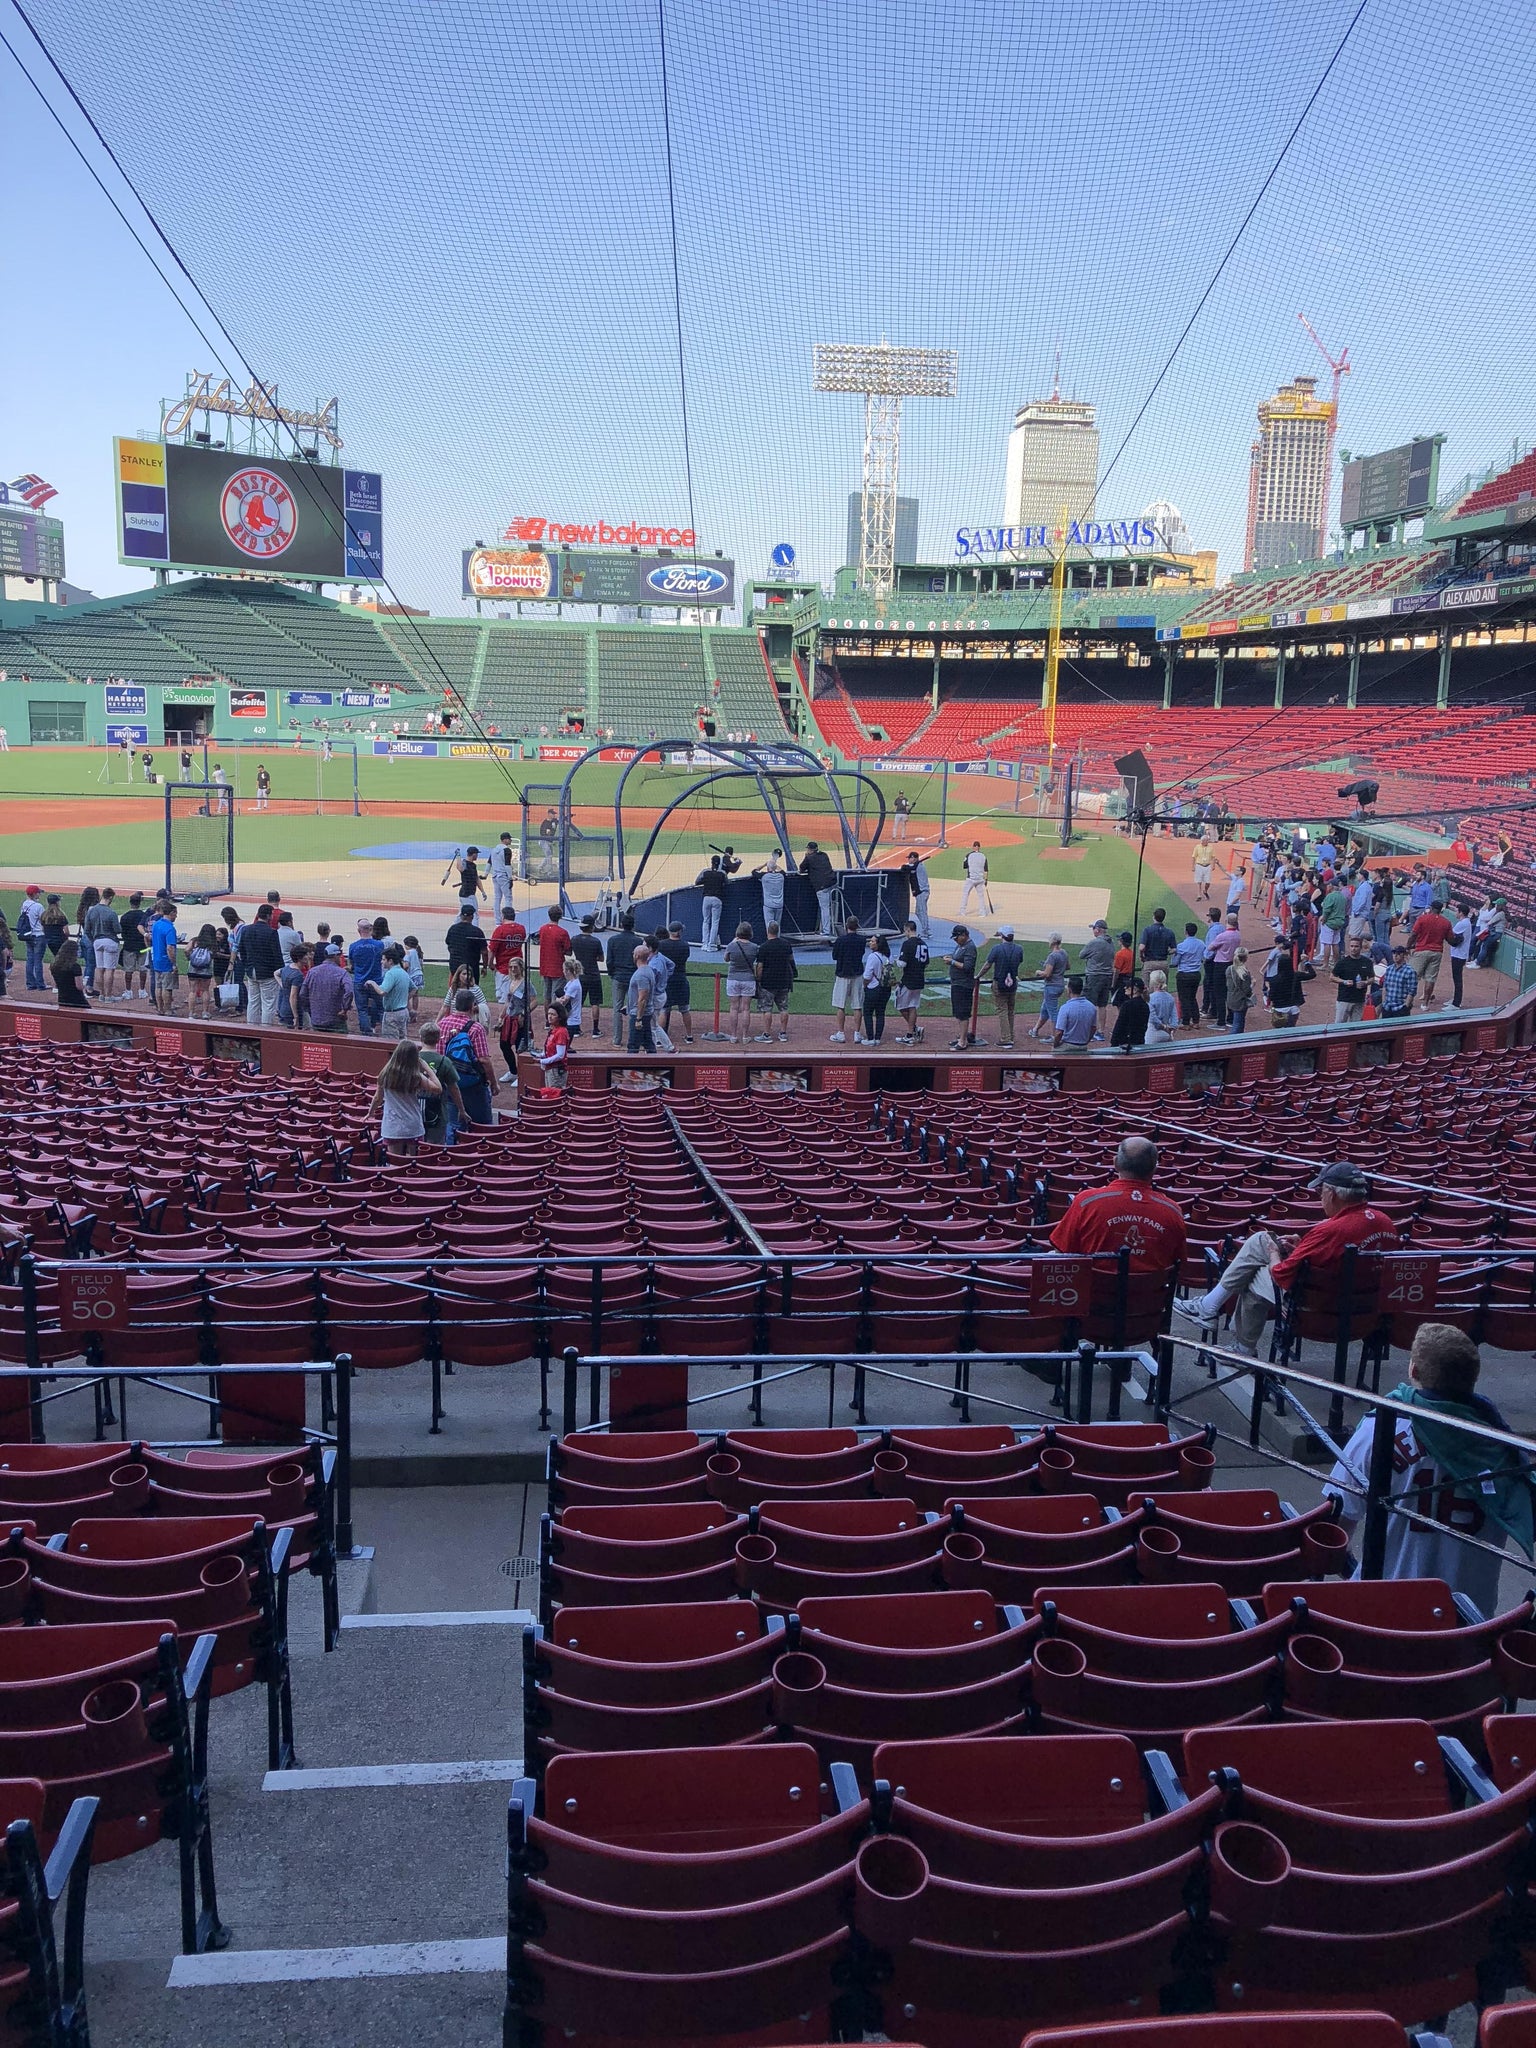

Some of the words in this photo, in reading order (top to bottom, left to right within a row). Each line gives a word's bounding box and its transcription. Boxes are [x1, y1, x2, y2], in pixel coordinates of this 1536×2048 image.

[162, 368, 236, 436] John
[238, 378, 344, 449] Hancock
[121, 455, 163, 467] STANLEY
[230, 475, 288, 504] BOSTON
[130, 516, 159, 526] StubHub
[230, 523, 258, 549] RED
[264, 526, 289, 552] SOX
[550, 523, 595, 543] new
[599, 519, 696, 547] balance
[955, 526, 1048, 557] SAMUEL
[1066, 518, 1156, 547] ADAMS
[347, 547, 381, 559] Ballpark
[495, 576, 542, 587] DONUTS
[663, 568, 712, 591] Ford
[1446, 592, 1463, 606] ALEX
[1464, 590, 1481, 604] AND
[1481, 587, 1497, 601] ANI
[108, 695, 144, 703] HARBOR
[174, 694, 215, 703] sunovion
[231, 698, 265, 706] Safelite
[347, 694, 370, 706] NESN
[390, 742, 423, 754] etBlue
[451, 745, 489, 756] GRANITE
[494, 745, 512, 757] CITY
[881, 763, 902, 771] TOYO
[903, 764, 926, 772] TIRES
[915, 944, 928, 963] 45
[1106, 1214, 1142, 1227] FENWAY
[1143, 1217, 1166, 1234] PARK
[1042, 1264, 1080, 1274] FIELD
[1392, 1262, 1429, 1270] FIELD
[71, 1275, 113, 1285] FIELD
[1046, 1275, 1073, 1284] BOX
[1395, 1273, 1421, 1281] BOX
[77, 1286, 107, 1296] BOX
[1039, 1288, 1079, 1306] 49
[1387, 1284, 1424, 1302] 48
[72, 1300, 116, 1320] 50
[1410, 1468, 1485, 1536] 16
